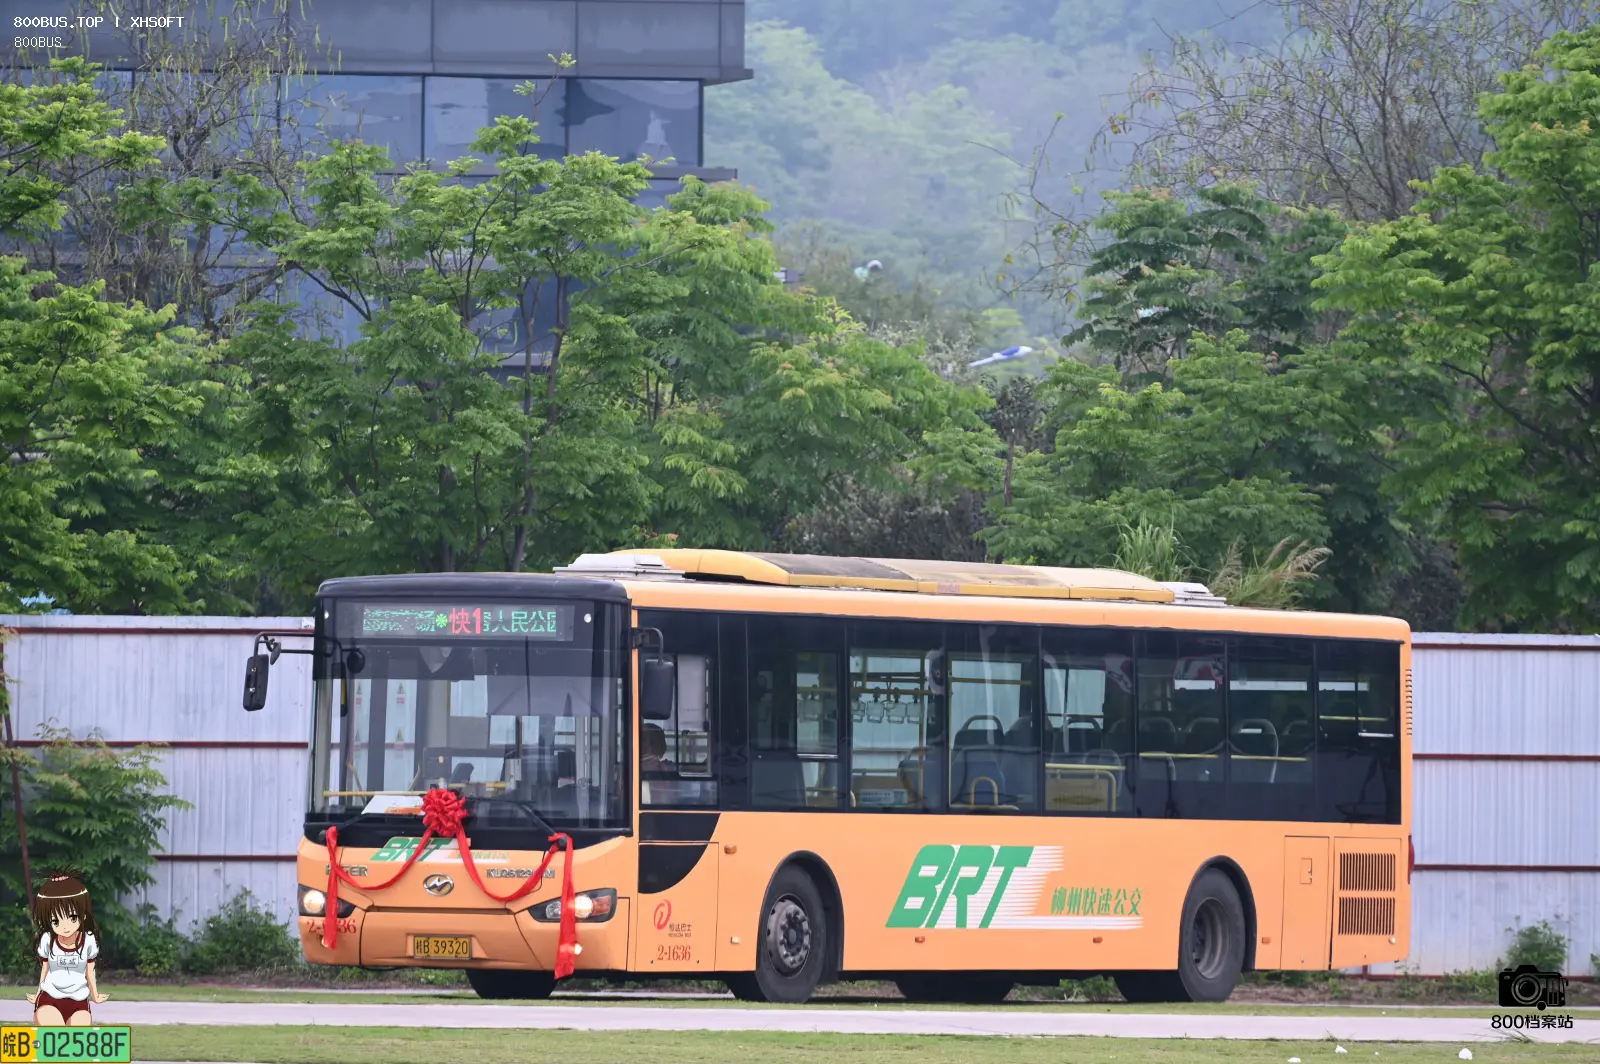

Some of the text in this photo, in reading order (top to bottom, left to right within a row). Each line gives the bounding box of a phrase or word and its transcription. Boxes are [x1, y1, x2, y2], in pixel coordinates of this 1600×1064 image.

[448, 607, 482, 635] 快1
[885, 844, 1035, 928] BRT
[1050, 887, 1143, 916] 柳州快速公交
